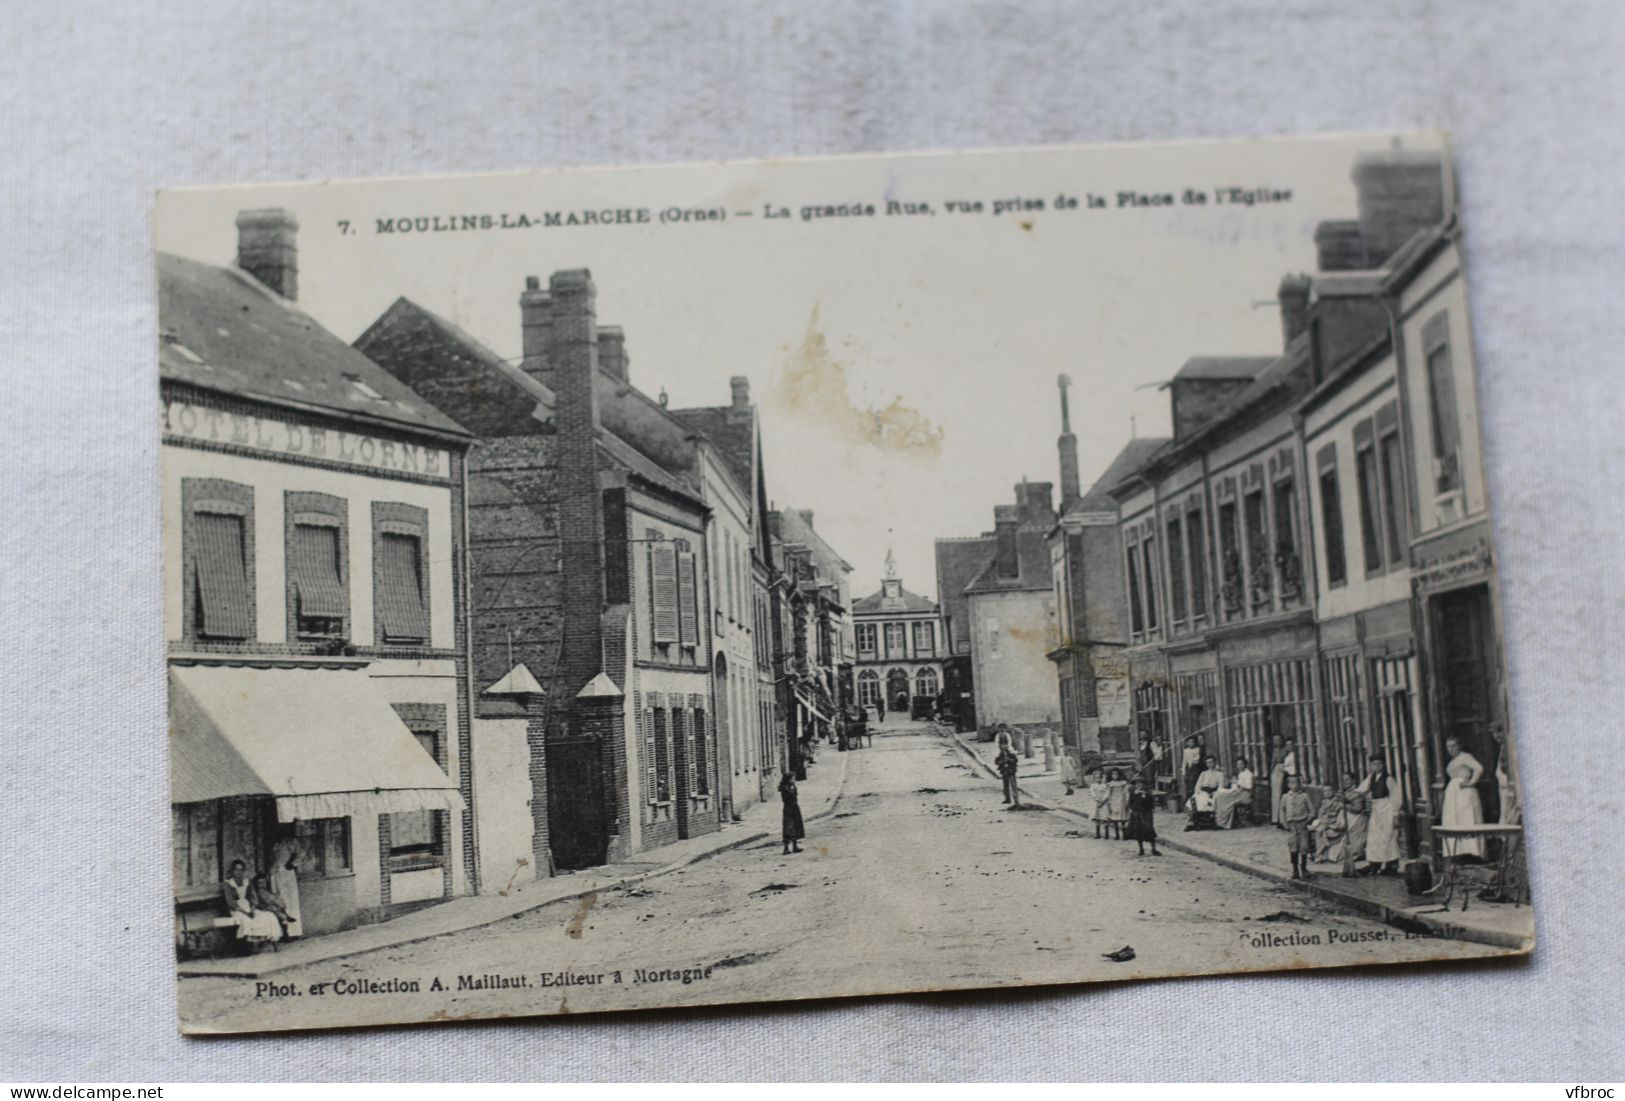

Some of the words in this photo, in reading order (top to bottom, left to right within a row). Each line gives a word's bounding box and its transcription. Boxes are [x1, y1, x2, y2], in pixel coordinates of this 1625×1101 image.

[336, 219, 356, 235] 7.
[375, 208, 651, 235] MOULINS-LA-MARCHE
[659, 206, 727, 224] (Orne)
[763, 203, 792, 220] La
[799, 201, 876, 221] grande
[885, 199, 936, 216] Rue,
[944, 199, 985, 214] vue
[992, 197, 1046, 216] prise
[1053, 191, 1079, 209] de
[1085, 189, 1106, 209] la
[1115, 189, 1175, 208] Place
[1181, 187, 1207, 206] de
[285, 422, 327, 456] DE
[255, 981, 303, 997] Phot.
[333, 977, 420, 996] Collection
[430, 976, 451, 992] A.
[541, 971, 605, 988] Editeur
[633, 966, 713, 985] Mortagne
